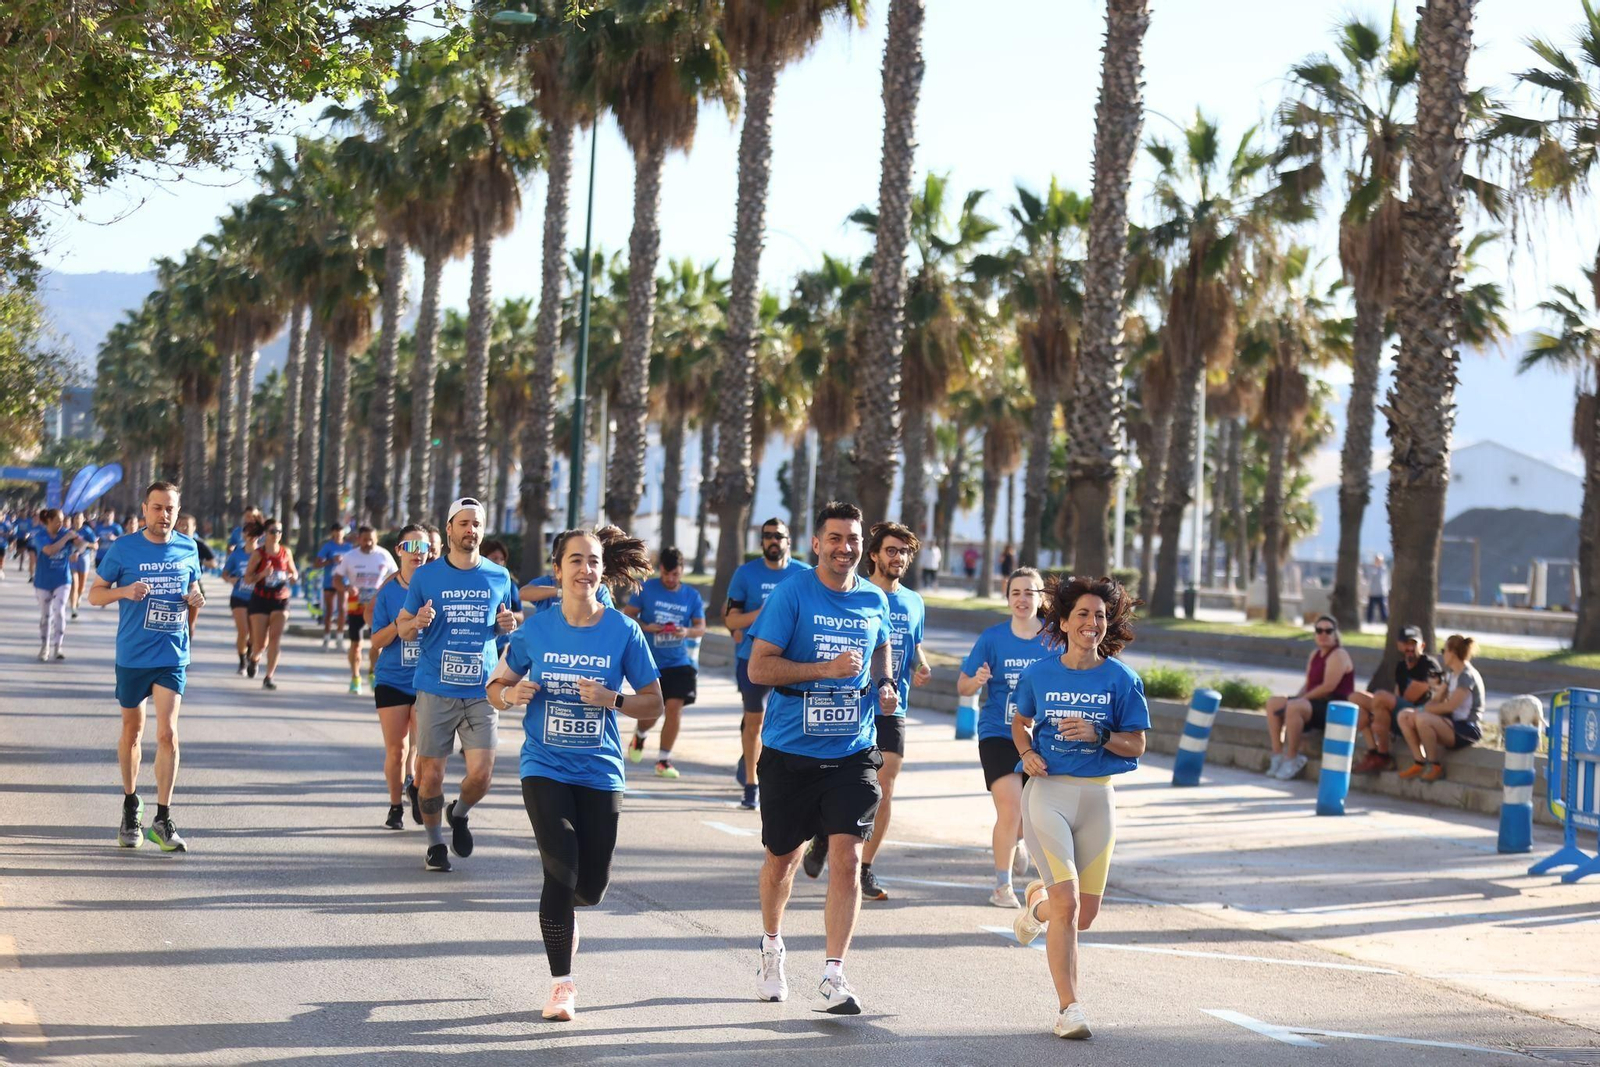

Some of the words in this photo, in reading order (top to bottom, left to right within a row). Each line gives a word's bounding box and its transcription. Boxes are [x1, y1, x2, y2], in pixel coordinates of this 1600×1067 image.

[442, 589, 490, 600] mayoral
[152, 612, 182, 622] 1551
[814, 614, 870, 630] mayoral
[813, 634, 869, 647] RUNNING
[543, 651, 611, 668] mayoral
[446, 663, 479, 674] 2078
[1045, 692, 1110, 705] mayoral
[812, 708, 855, 721] 1607
[1045, 709, 1107, 720] RUNNING
[552, 719, 597, 733] 1586
